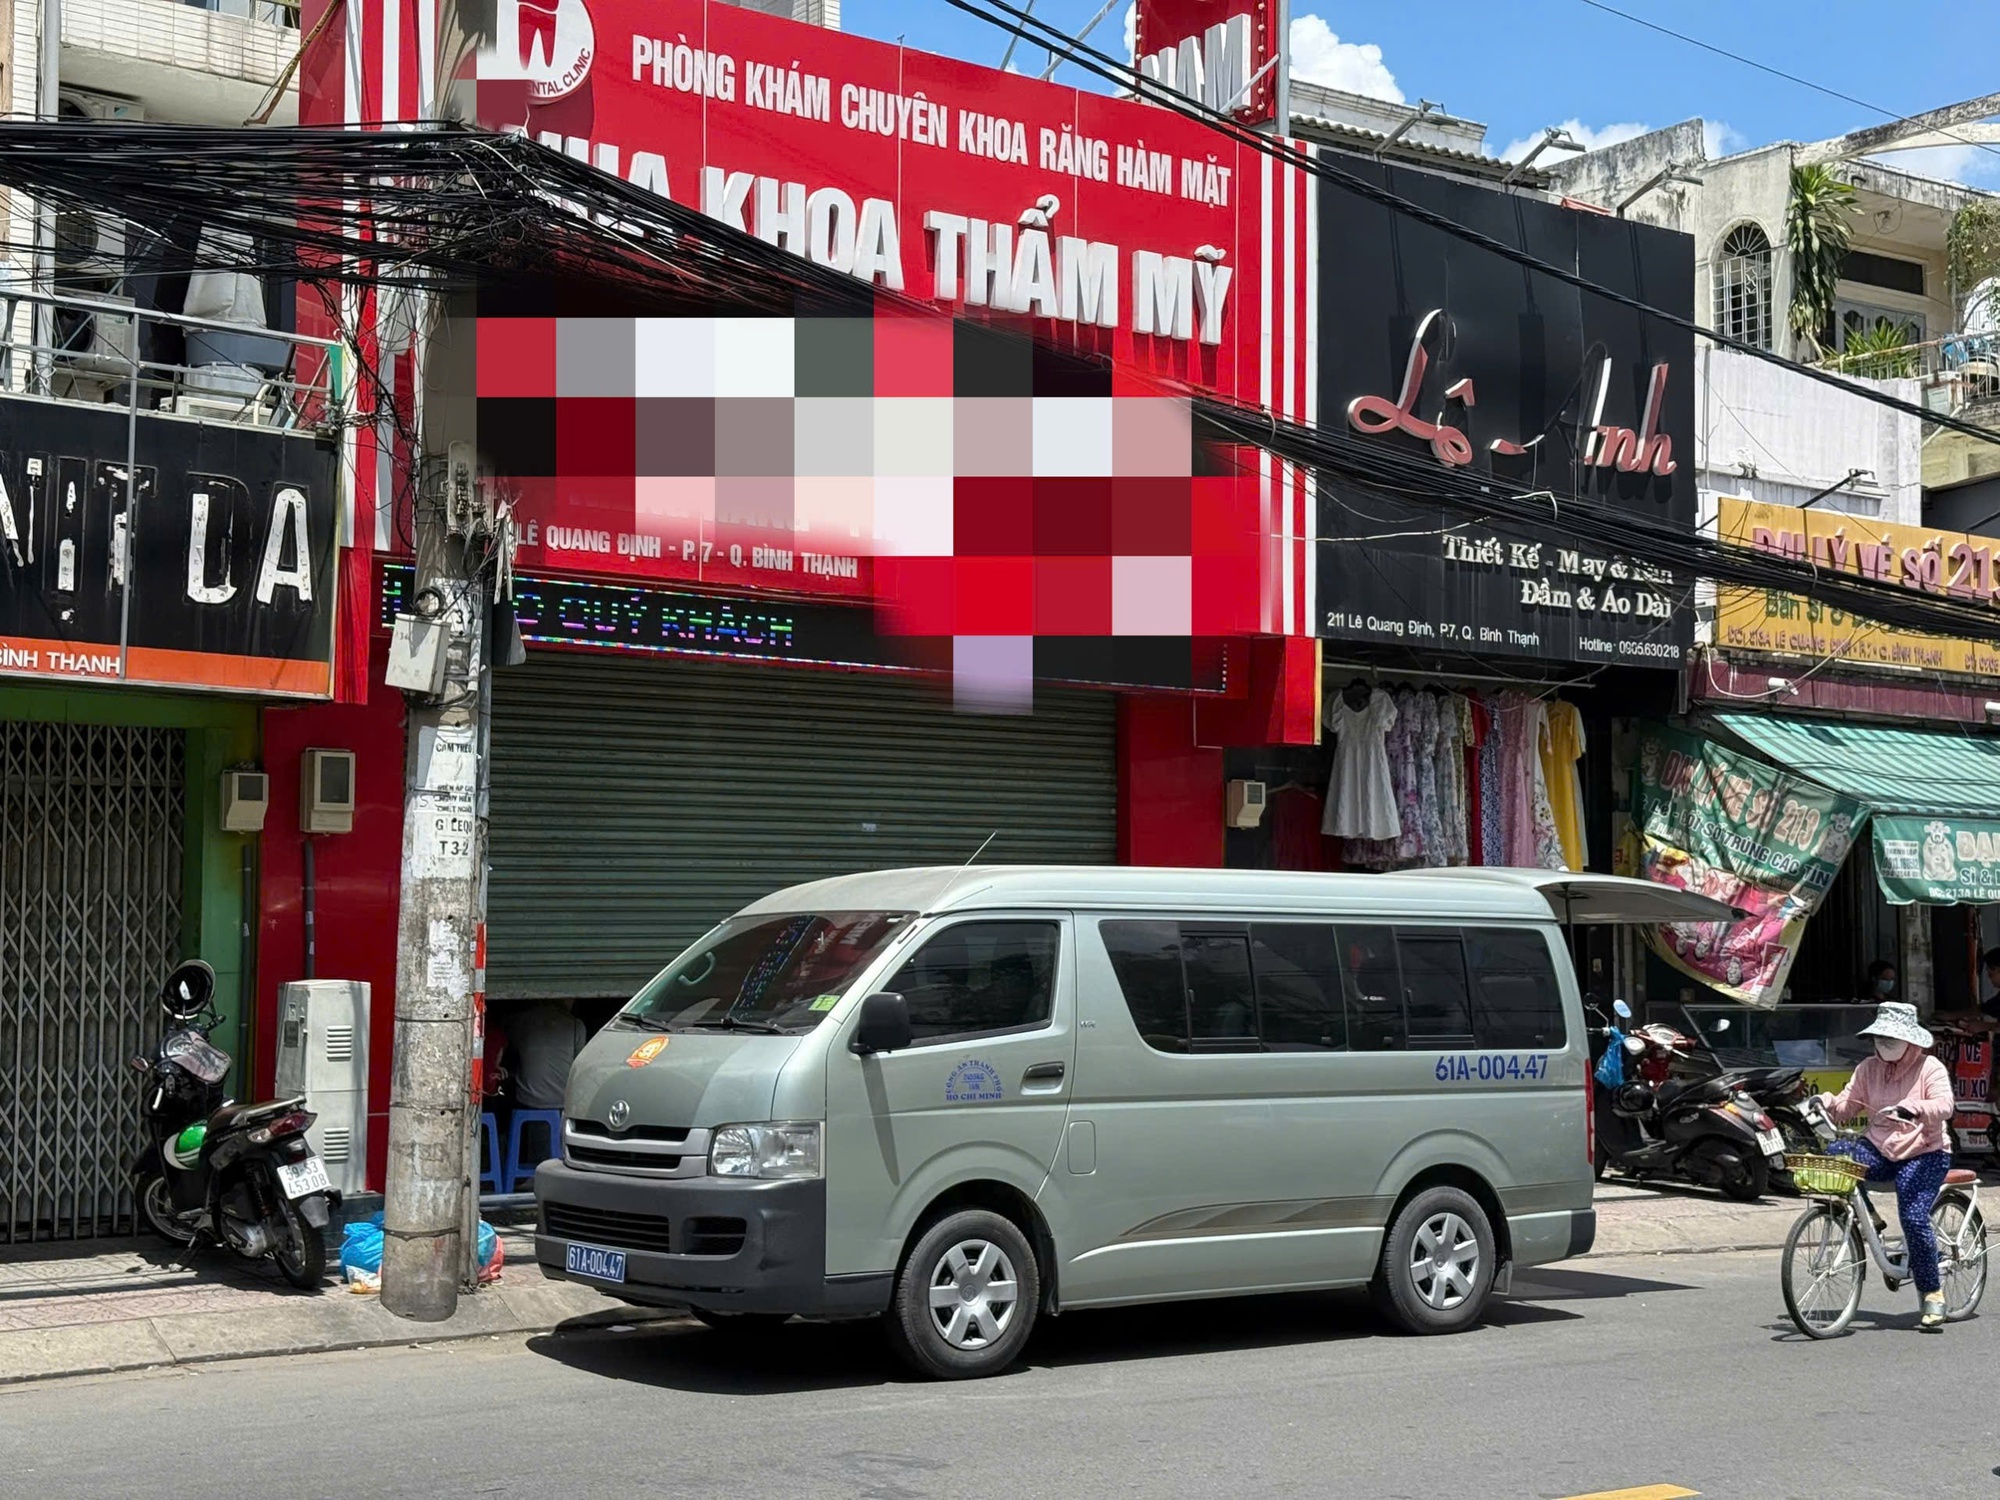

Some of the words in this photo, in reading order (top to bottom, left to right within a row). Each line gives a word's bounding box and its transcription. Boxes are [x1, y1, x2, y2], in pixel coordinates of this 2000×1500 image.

[562, 47, 591, 88] CLINIC
[632, 33, 735, 102] PHÒNG
[745, 60, 830, 123] KHÁM
[840, 83, 948, 149] CHUYÊN
[958, 109, 1029, 166] KHOA
[1039, 122, 1109, 182] RĂNG
[1116, 139, 1172, 195] HÀM
[1180, 153, 1231, 208] MẶT
[700, 166, 904, 290] KHOA
[924, 193, 1118, 328] THẨM
[1133, 244, 1233, 345] MỸ
[516, 519, 539, 547] LÊ
[546, 525, 611, 554] QUANG
[617, 533, 662, 563] ĐỊNH
[801, 552, 858, 582] THẠNH
[1442, 534, 1504, 566] Thiết
[1508, 542, 1543, 570] Kế
[1556, 549, 1608, 582] May
[1899, 535, 1945, 592] SỐ
[1519, 577, 1572, 608] Đầm
[1576, 587, 1596, 611] &
[1601, 583, 1632, 615] Áo
[1635, 591, 1673, 619] Dài
[661, 605, 793, 647] KHÁCH
[1327, 612, 1345, 628] 211
[1348, 614, 1363, 629] Lê
[1367, 616, 1404, 636] Quang
[1408, 620, 1435, 639] Định,
[1461, 625, 1475, 640] Q.
[1479, 627, 1503, 643] Bình
[1507, 629, 1540, 648] Thạnh
[46, 651, 121, 676] THẠNH
[1773, 799, 1821, 852] 213
[1723, 829, 1772, 863] TRÚNG
[1769, 849, 1801, 877] CÁC
[1435, 1054, 1549, 1081] 61A-004.47
[978, 1092, 1002, 1100] MINH
[568, 1246, 623, 1278] 61A-004.47
